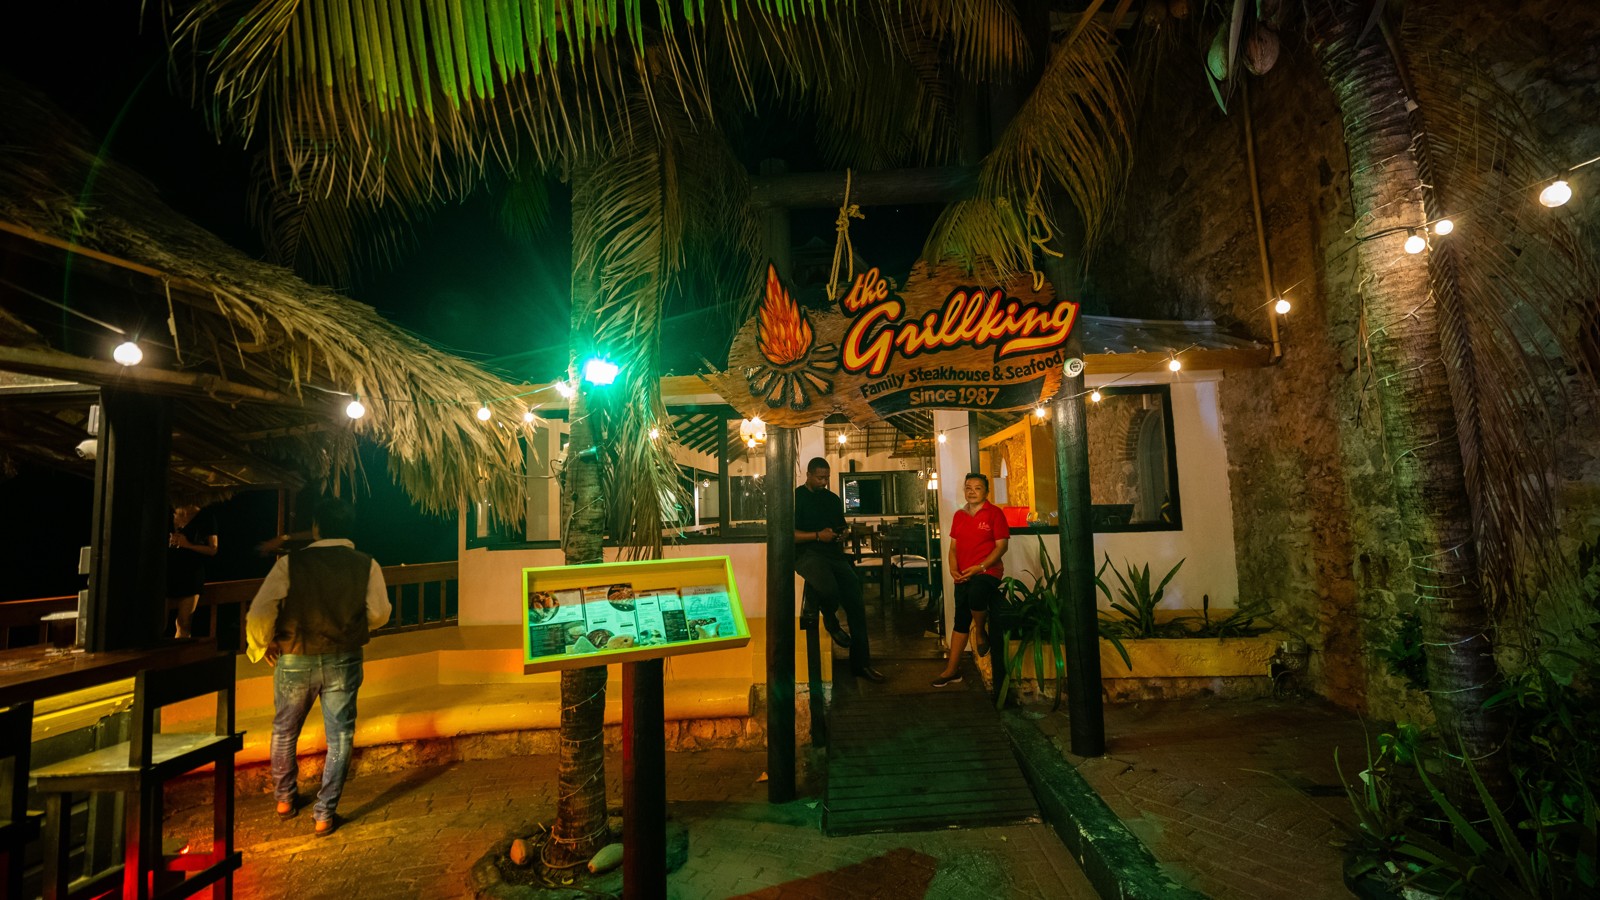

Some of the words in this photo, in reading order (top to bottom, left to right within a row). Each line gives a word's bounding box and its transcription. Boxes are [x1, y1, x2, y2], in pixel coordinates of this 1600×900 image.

[846, 267, 889, 311] the
[843, 290, 1080, 375] Grillking
[861, 373, 905, 398] Family
[909, 365, 990, 382] Steakhouse
[993, 365, 1003, 381] &
[1006, 352, 1063, 380] Seafood
[910, 387, 956, 404] since
[959, 387, 1000, 406] 1987
